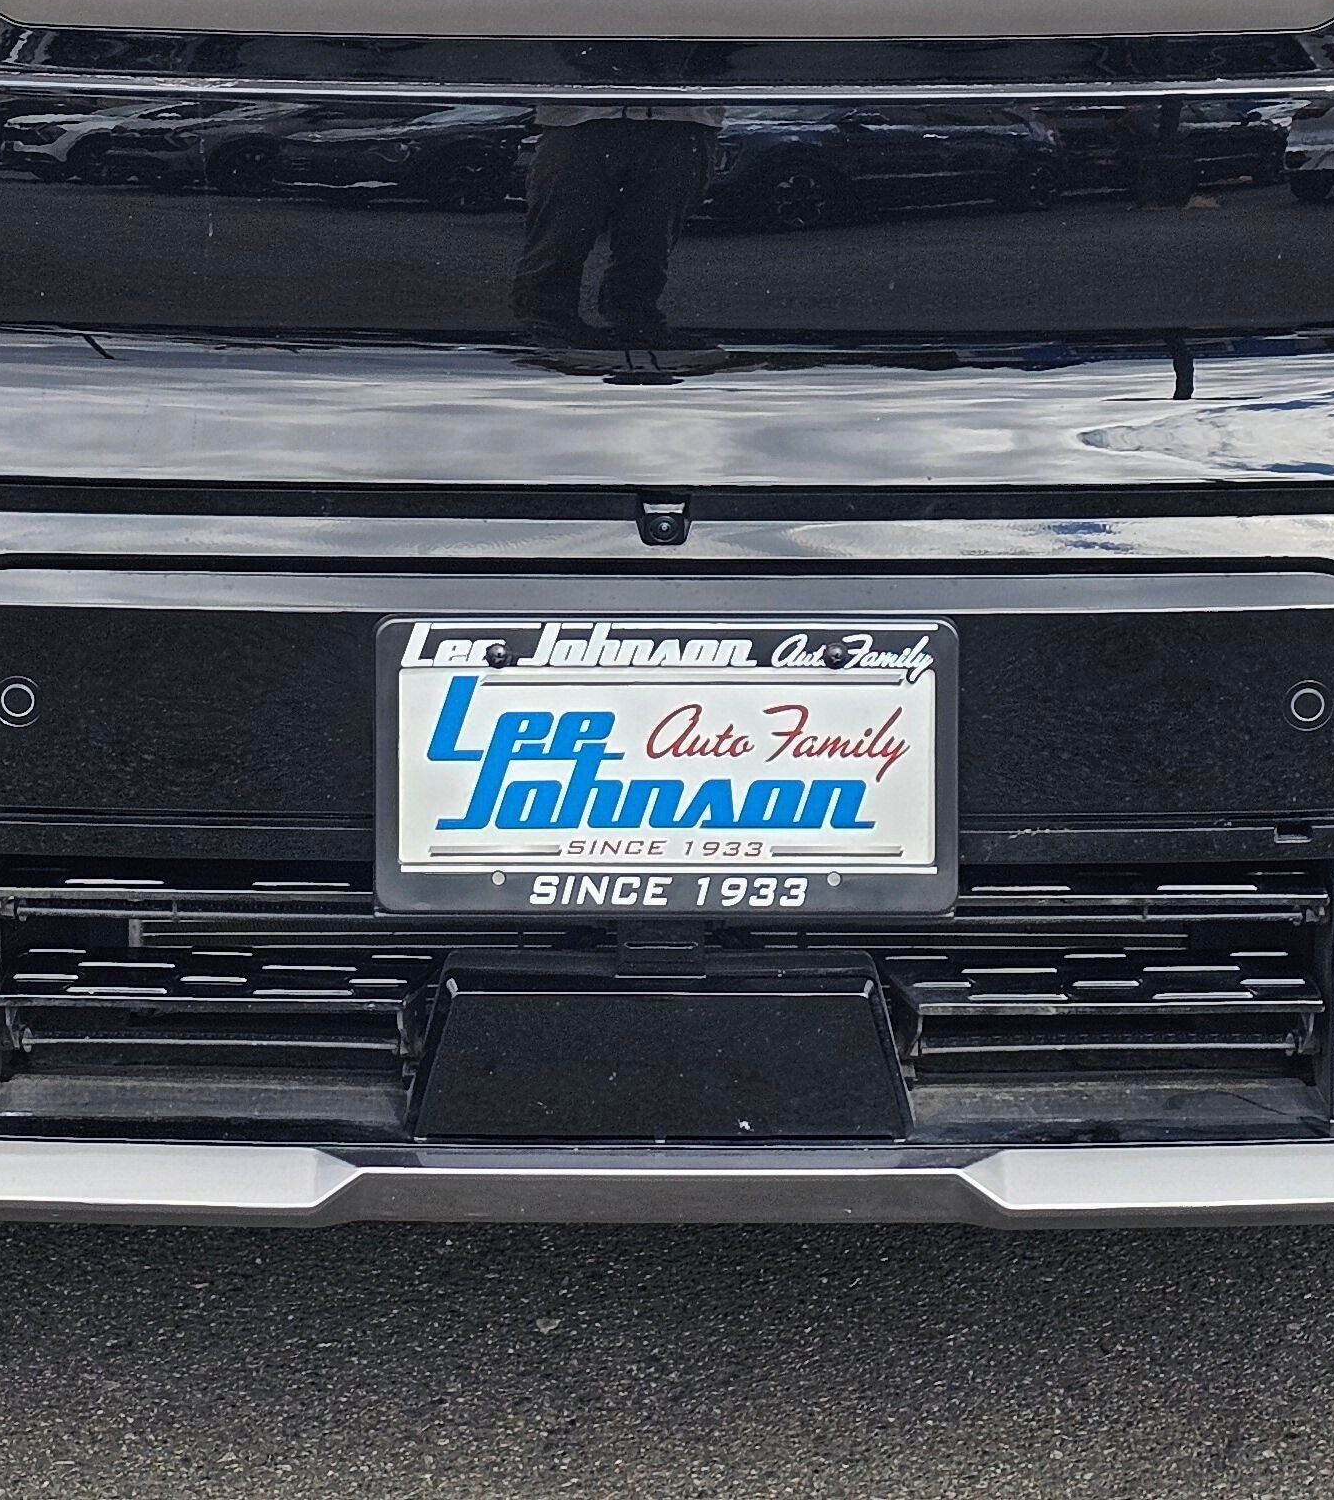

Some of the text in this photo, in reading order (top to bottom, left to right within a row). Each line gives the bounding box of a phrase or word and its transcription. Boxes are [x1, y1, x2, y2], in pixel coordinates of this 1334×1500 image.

[400, 622, 934, 682] Lee Johnson Aut Family
[427, 675, 911, 783] Lee Auto Family
[435, 746, 876, 830] Johnson
[567, 839, 764, 858] SINCE 1933
[529, 874, 810, 907] SINCE 1933
